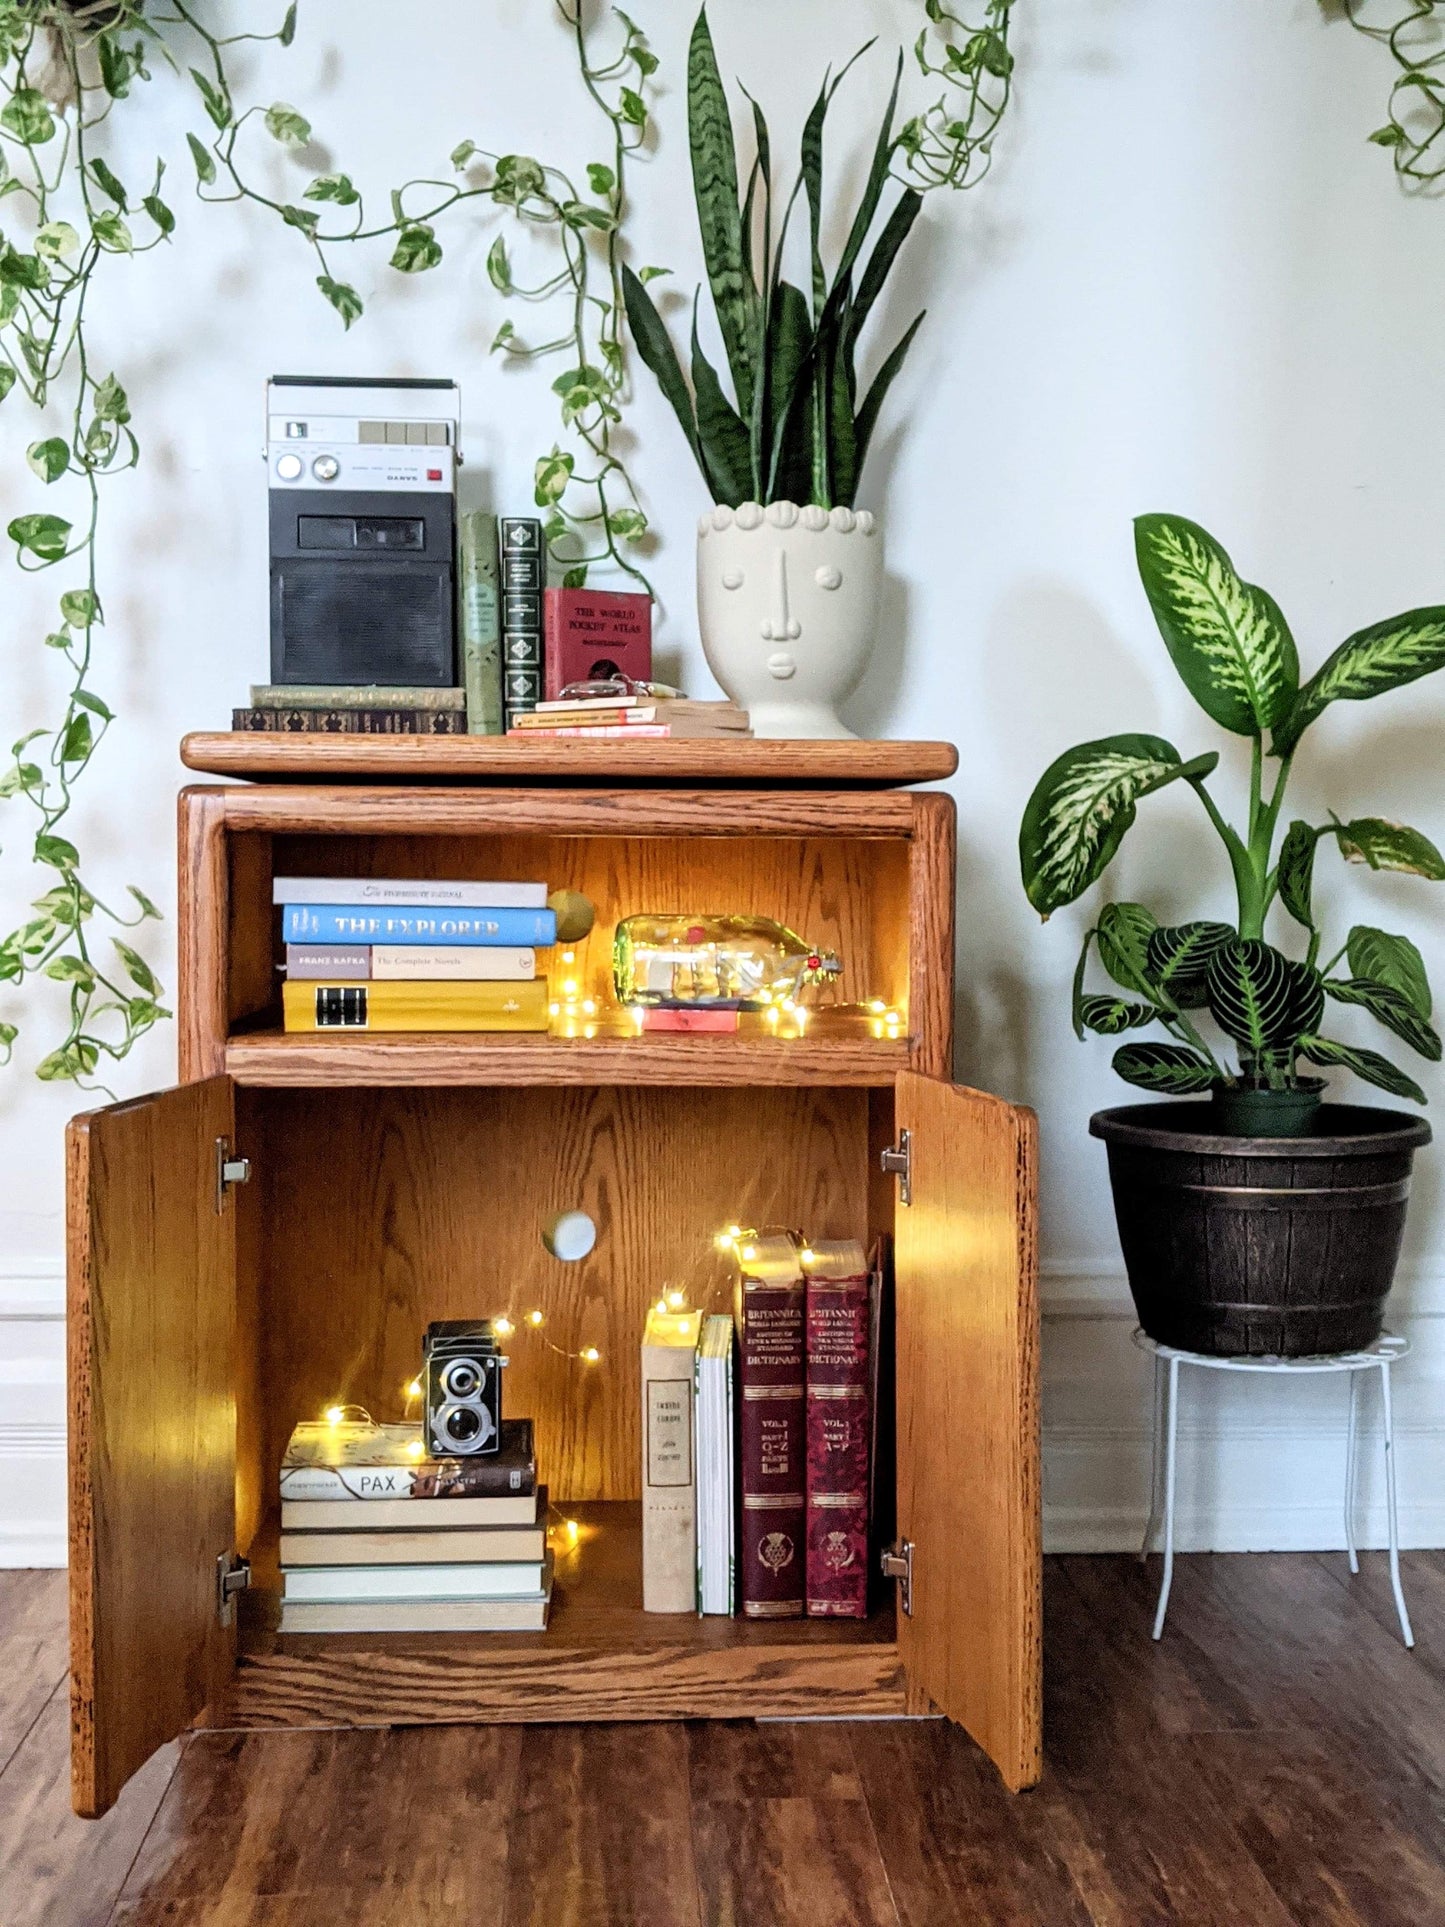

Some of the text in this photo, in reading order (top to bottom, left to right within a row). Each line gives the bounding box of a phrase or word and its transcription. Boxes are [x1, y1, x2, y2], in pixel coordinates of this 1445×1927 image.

[575, 607, 635, 620] THE WORLD
[569, 620, 641, 633] POCKET ATLAS
[335, 917, 500, 936] THE EXPLORER
[299, 956, 366, 965] FRANZ KAFKA
[360, 1476, 395, 1491] PAX
